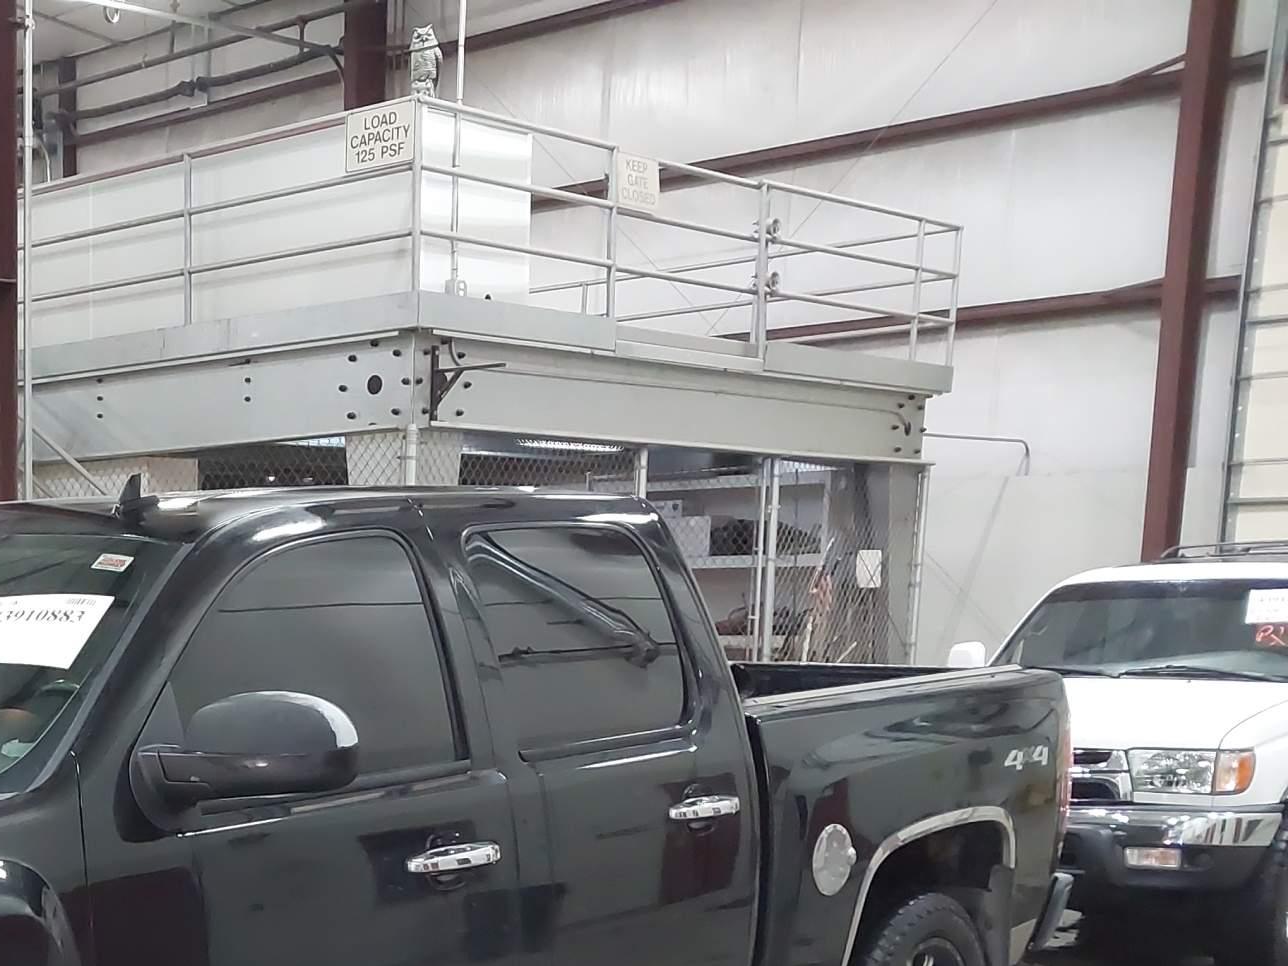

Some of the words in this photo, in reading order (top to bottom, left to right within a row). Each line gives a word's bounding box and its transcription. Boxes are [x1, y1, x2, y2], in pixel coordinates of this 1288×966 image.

[364, 111, 398, 131] LOAD
[350, 124, 411, 149] CAPACITY
[355, 148, 376, 164] 125
[380, 142, 405, 159] PSF
[625, 159, 648, 174] KEEP
[627, 174, 649, 190] GATE
[622, 186, 657, 205] CLOSED
